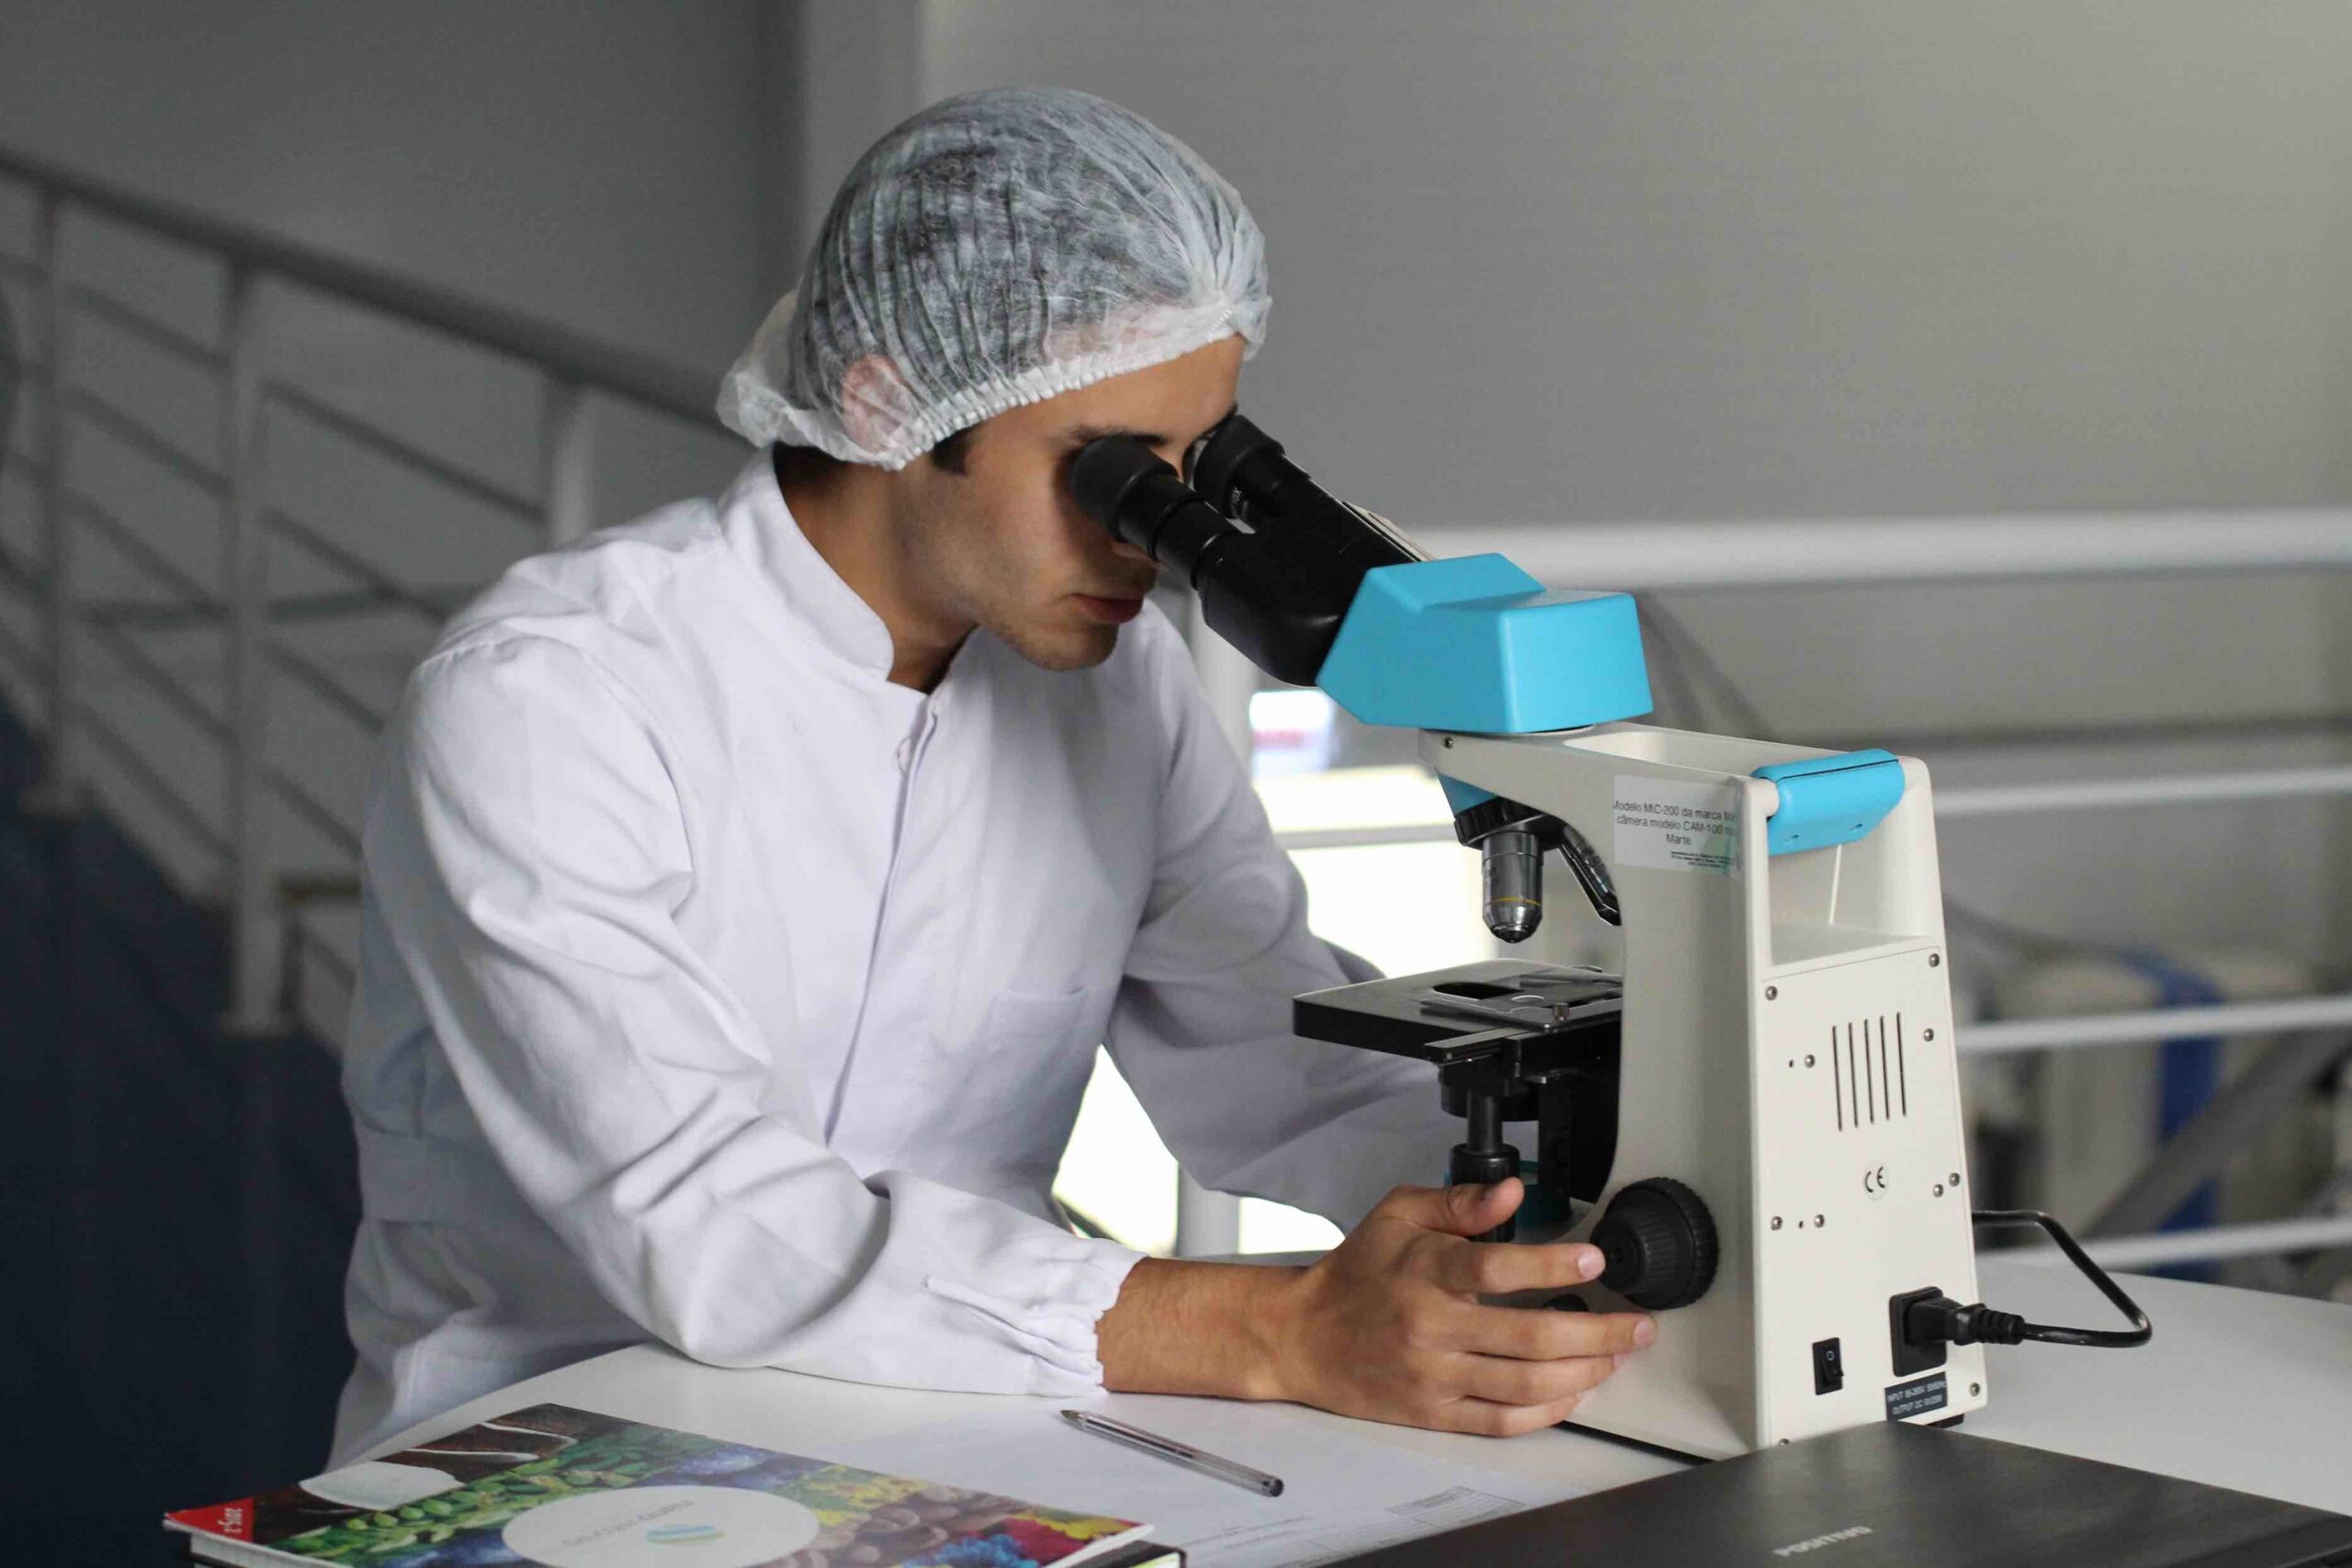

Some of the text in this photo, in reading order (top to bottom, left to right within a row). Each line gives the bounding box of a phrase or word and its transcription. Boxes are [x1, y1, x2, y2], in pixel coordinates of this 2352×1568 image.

[1644, 803, 1679, 817] MIC-200
[1682, 808, 1692, 818] da
[1694, 809, 1722, 820] marca
[1617, 815, 1647, 827] câmera
[1649, 819, 1681, 829] modelo
[1683, 820, 1724, 835] CAM-100
[1666, 833, 1691, 845] Marte
